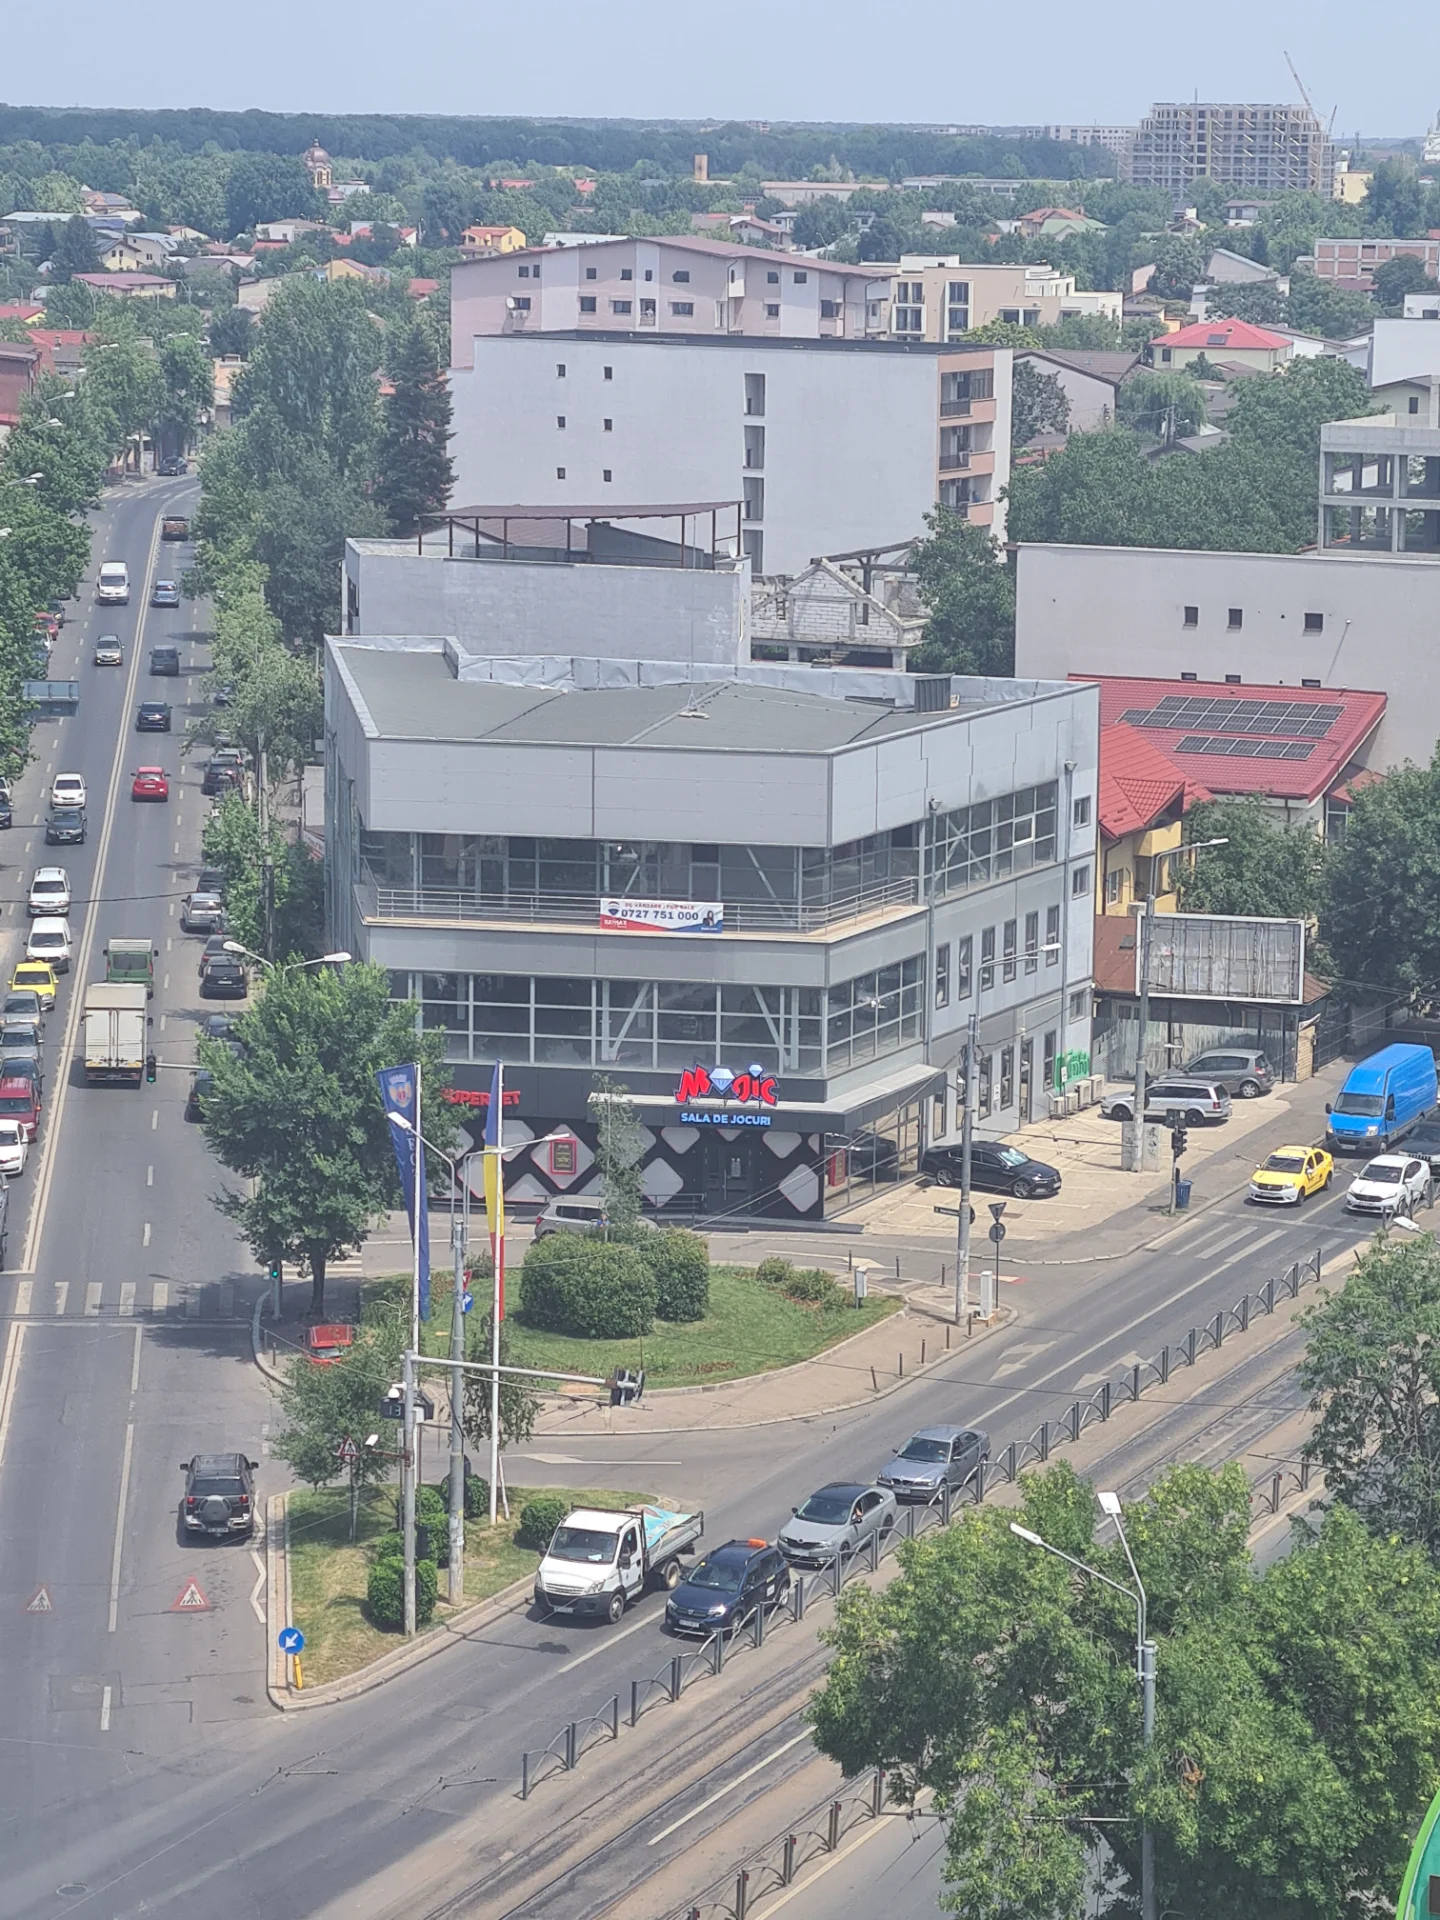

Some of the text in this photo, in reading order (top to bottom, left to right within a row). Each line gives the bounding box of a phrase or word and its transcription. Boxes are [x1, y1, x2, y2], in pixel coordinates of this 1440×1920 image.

[621, 909, 699, 921] 0727 751 000
[681, 1112, 771, 1126] SALA DE JOCURI
